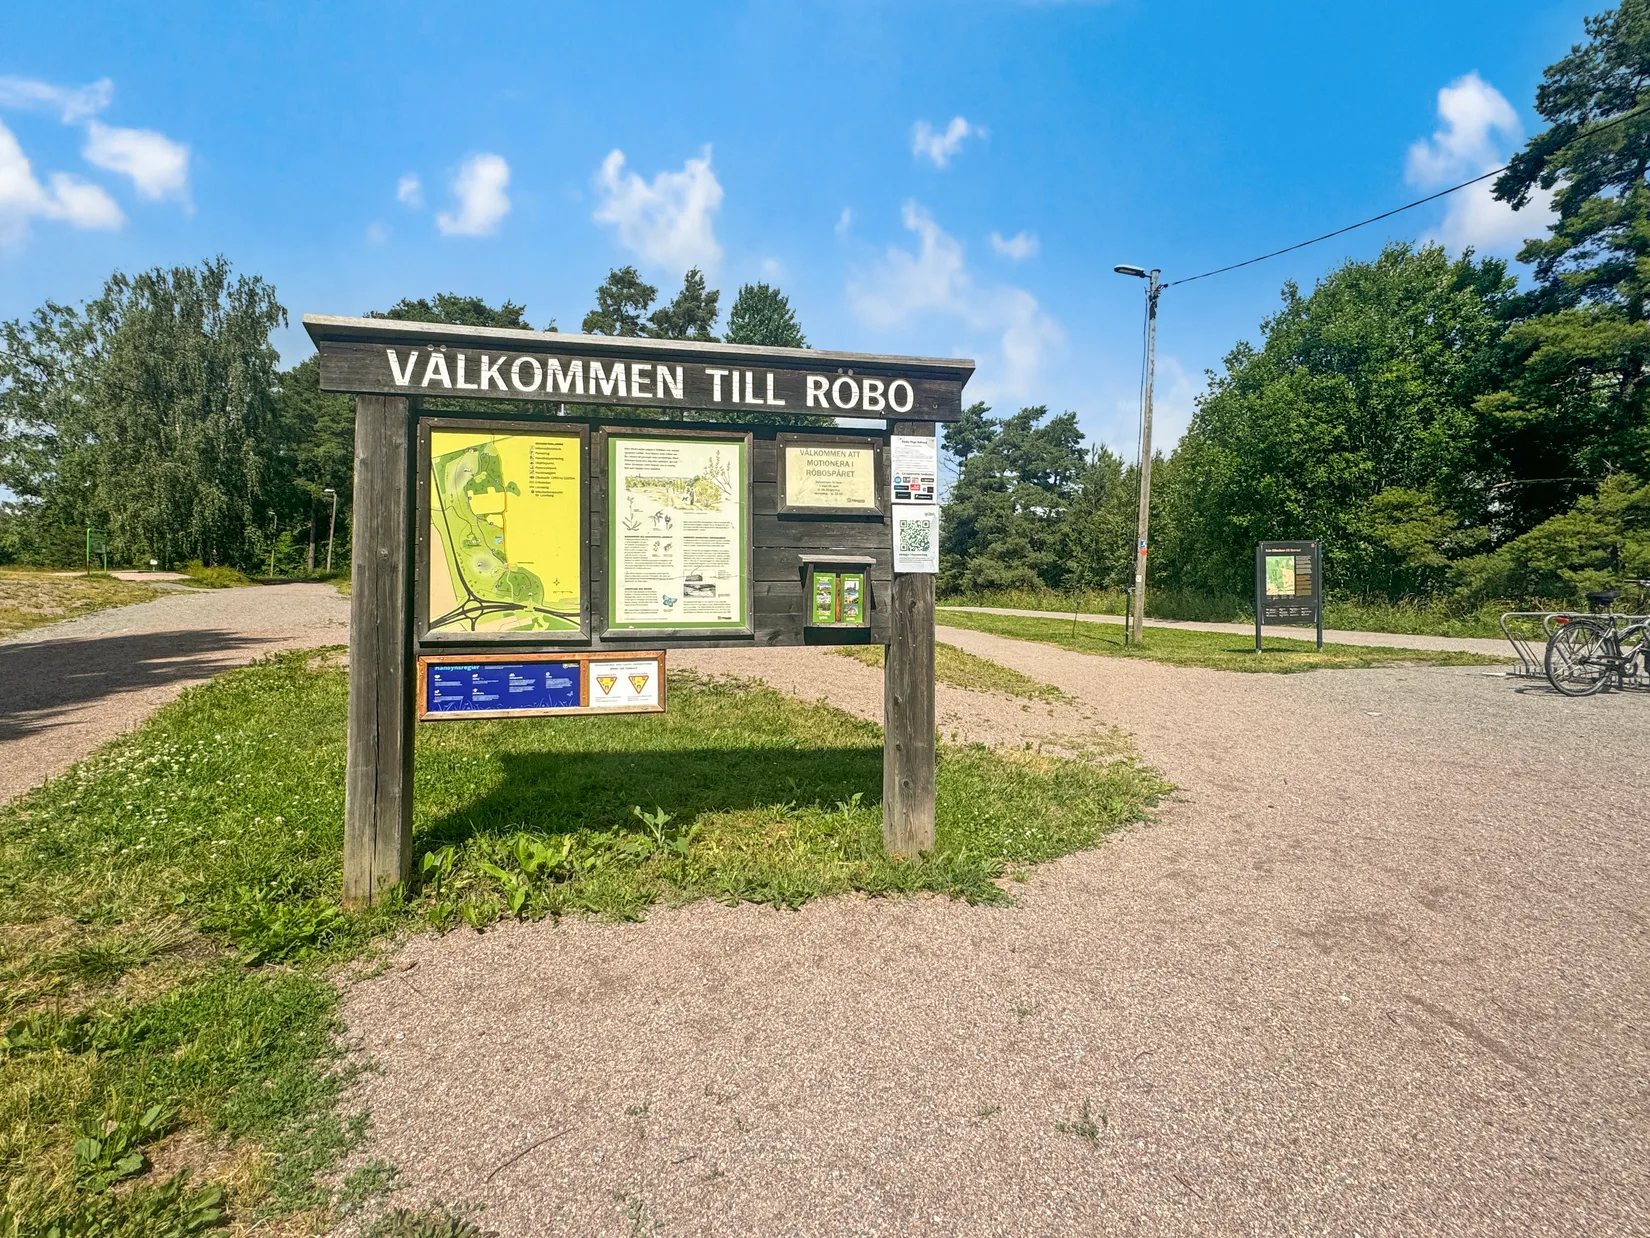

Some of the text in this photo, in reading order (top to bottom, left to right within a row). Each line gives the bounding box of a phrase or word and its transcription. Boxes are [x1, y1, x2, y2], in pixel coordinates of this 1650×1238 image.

[386, 344, 915, 414] VÄLKOMMEN TILL RÖBO
[800, 448, 847, 457] VÄLKOMMEN
[807, 459, 850, 467] MOTIONERA
[806, 469, 855, 477] RÖBOSPÅRET
